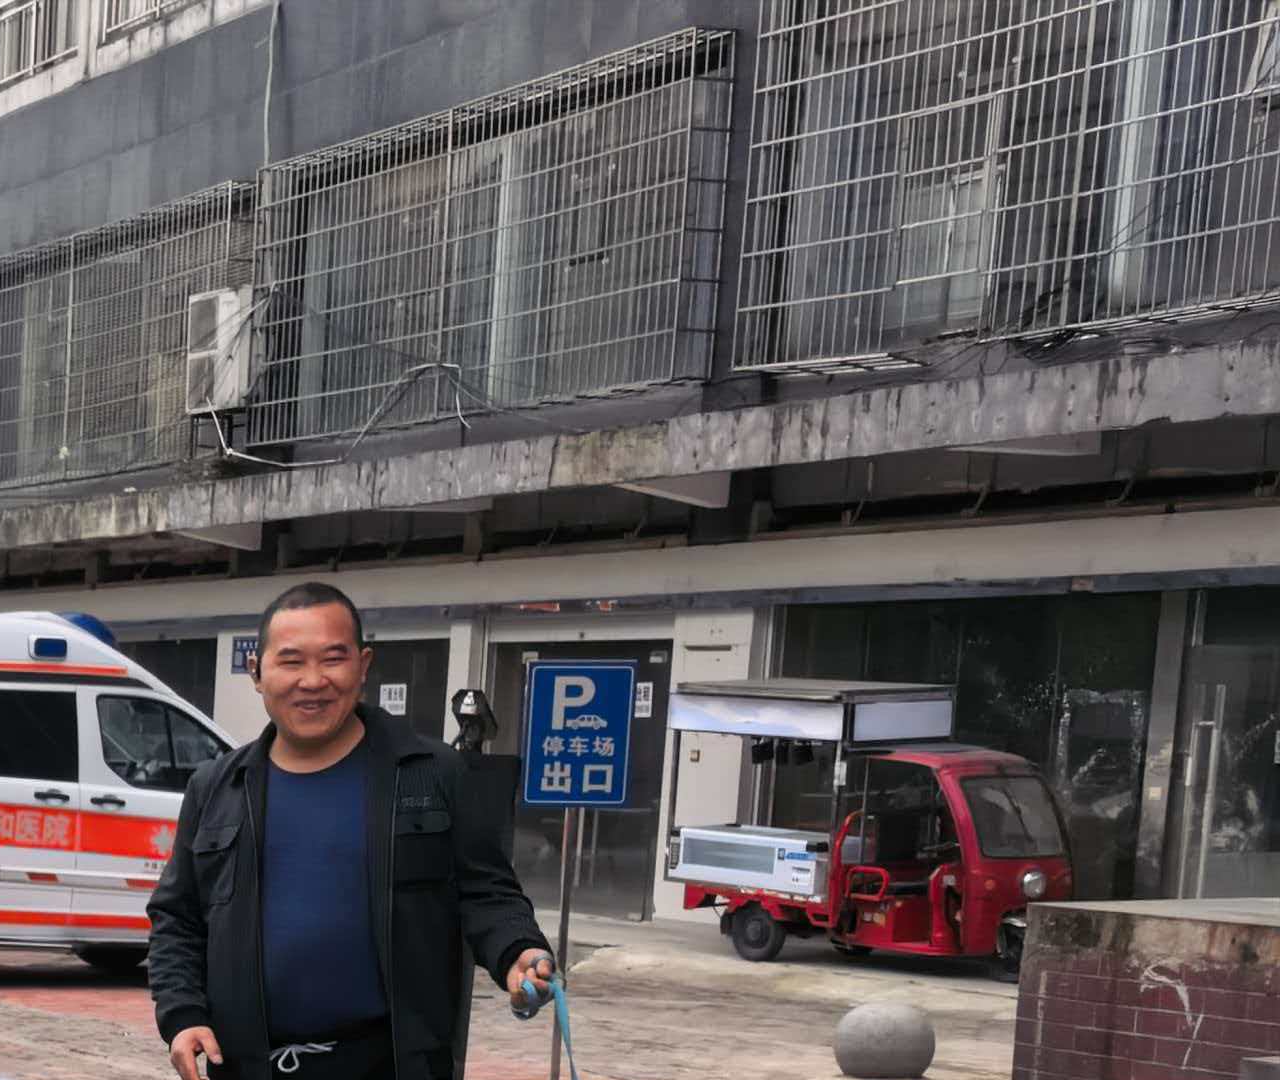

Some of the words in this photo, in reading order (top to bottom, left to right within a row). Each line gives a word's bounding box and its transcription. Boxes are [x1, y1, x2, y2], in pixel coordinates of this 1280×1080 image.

[551, 675, 596, 730] P
[542, 736, 615, 757] 停车场
[540, 761, 614, 793] 出口
